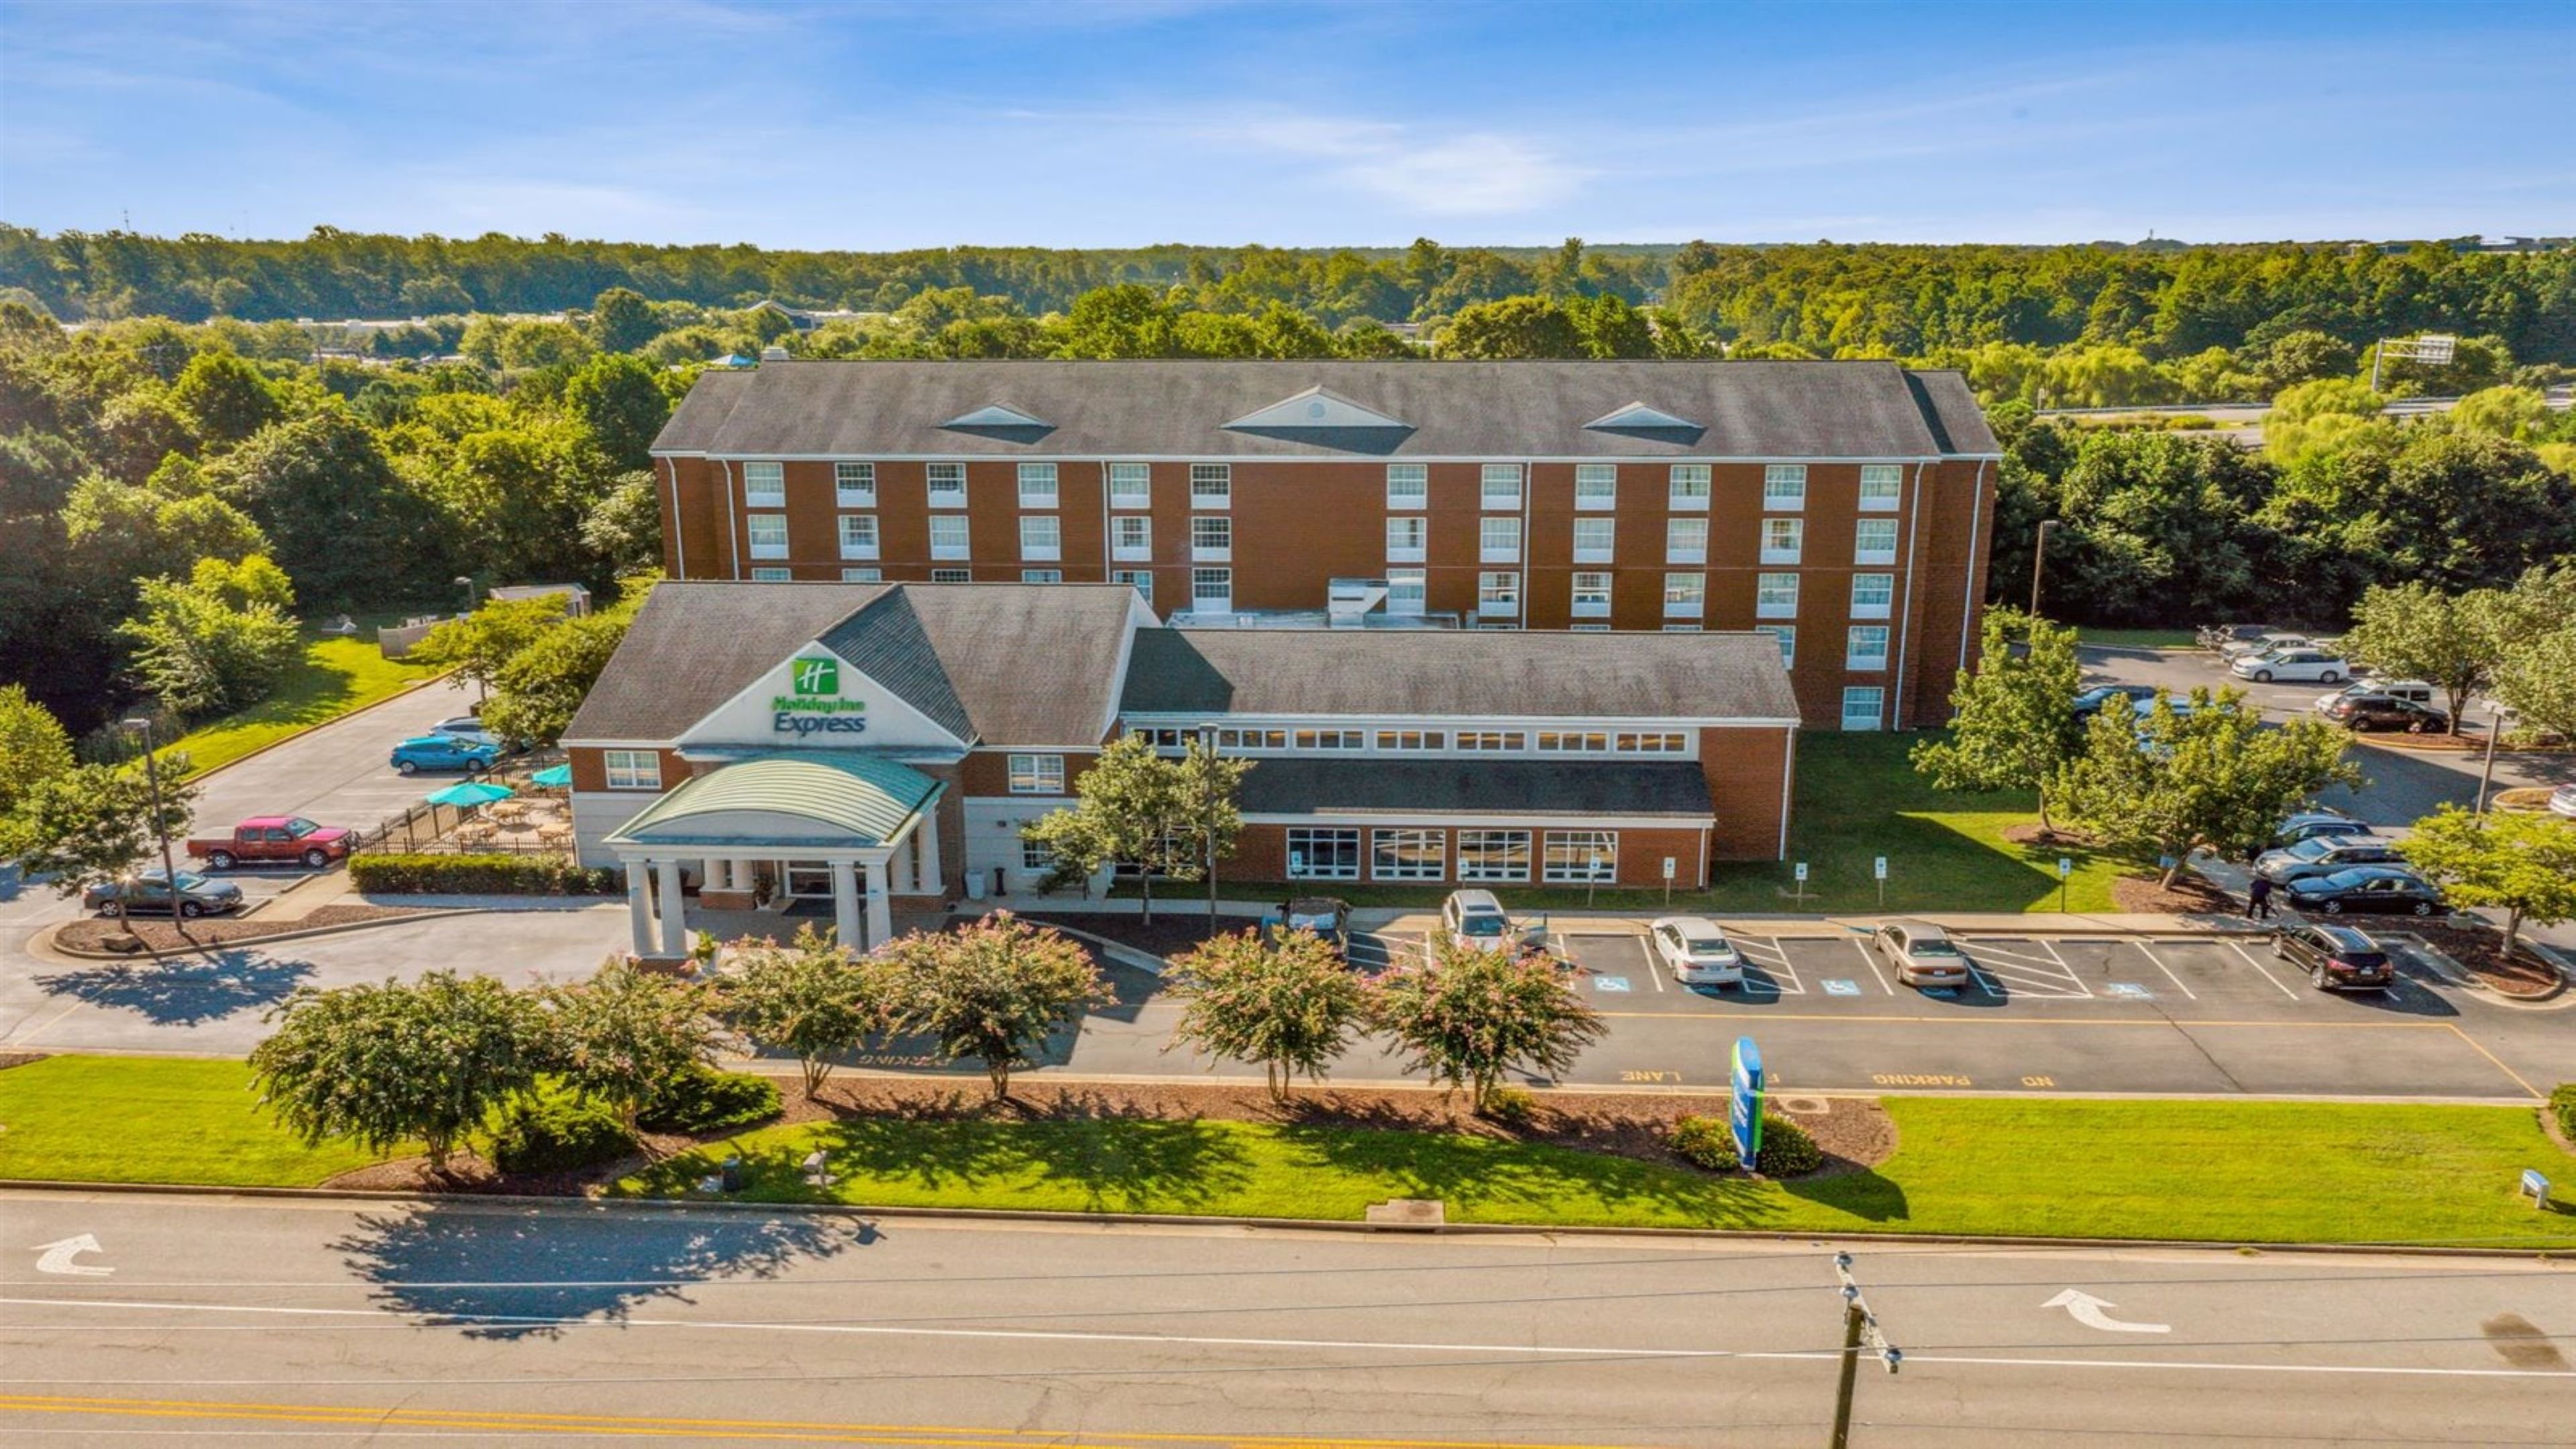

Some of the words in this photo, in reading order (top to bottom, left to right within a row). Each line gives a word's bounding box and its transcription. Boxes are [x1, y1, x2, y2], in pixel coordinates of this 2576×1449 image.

[773, 696, 837, 713] Holiday
[839, 696, 865, 711] Inn
[774, 712, 866, 737] Express
[1620, 1071, 1682, 1081] LANE
[1872, 1075, 1971, 1086] PARKING
[2021, 1076, 2054, 1087] NO
